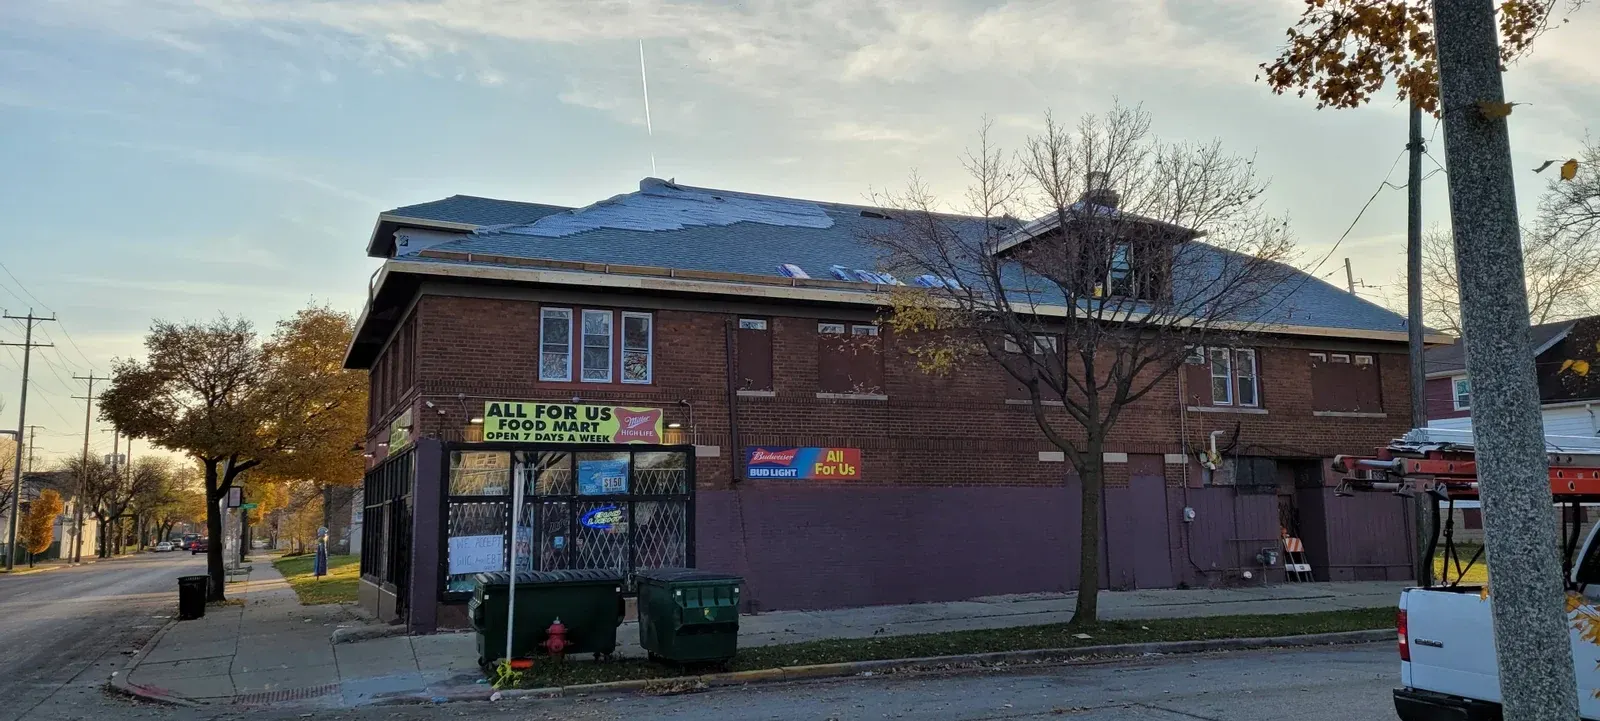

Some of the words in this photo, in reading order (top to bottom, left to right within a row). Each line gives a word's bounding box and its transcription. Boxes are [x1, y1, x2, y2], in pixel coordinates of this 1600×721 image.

[486, 403, 527, 418] ALL
[535, 405, 577, 420] FOR
[585, 407, 612, 421] US
[498, 419, 546, 431] FOOD
[552, 421, 600, 433] MART
[624, 415, 650, 429] Miller
[486, 431, 519, 441] OPEN
[523, 433, 531, 441] 7
[535, 433, 564, 442] DAYS
[567, 434, 576, 442] A
[579, 434, 610, 443] WEEK
[621, 429, 638, 437] HIGH
[751, 451, 794, 461] Budweiser
[826, 450, 844, 463] All
[749, 468, 770, 477] BUD
[770, 468, 797, 477] LIGHT
[815, 462, 836, 475] For
[839, 463, 856, 476] Us
[604, 477, 622, 488] $1.50
[456, 537, 470, 549] WE
